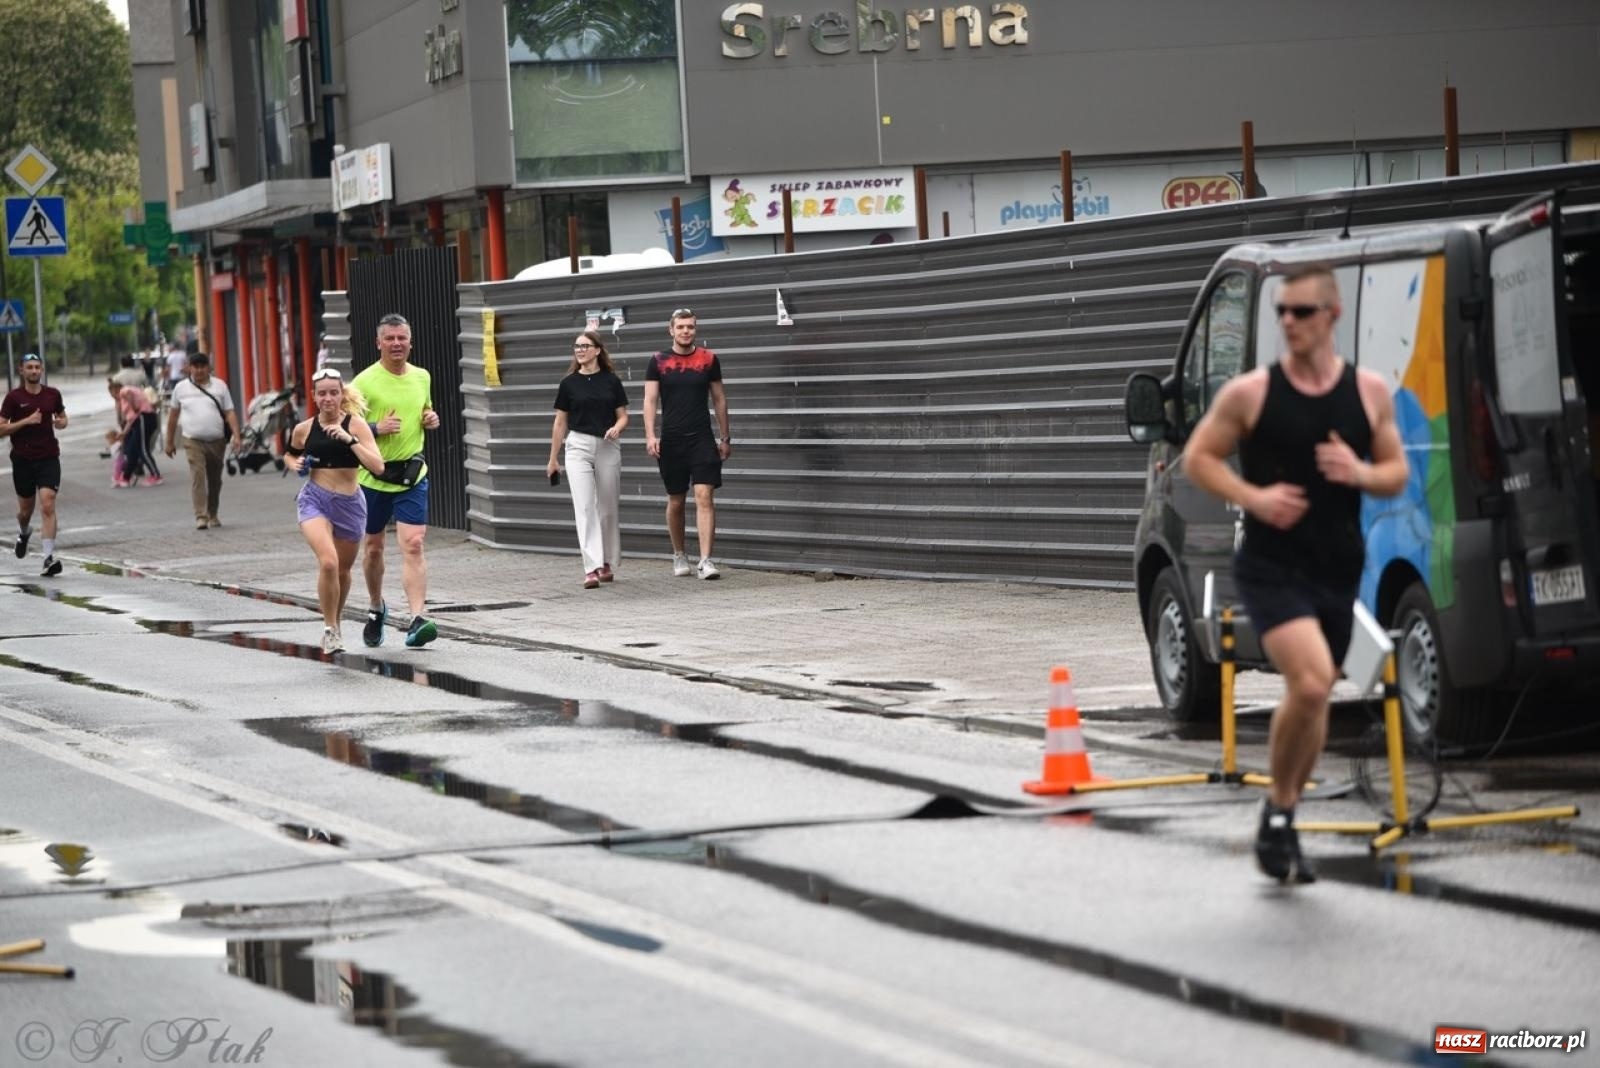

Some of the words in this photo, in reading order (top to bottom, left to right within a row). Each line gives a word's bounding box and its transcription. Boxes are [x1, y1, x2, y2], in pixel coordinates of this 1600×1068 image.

[721, 0, 1028, 58] Srebrna
[770, 182, 810, 193] SKLEP
[816, 178, 903, 191] ZABAWKOWY
